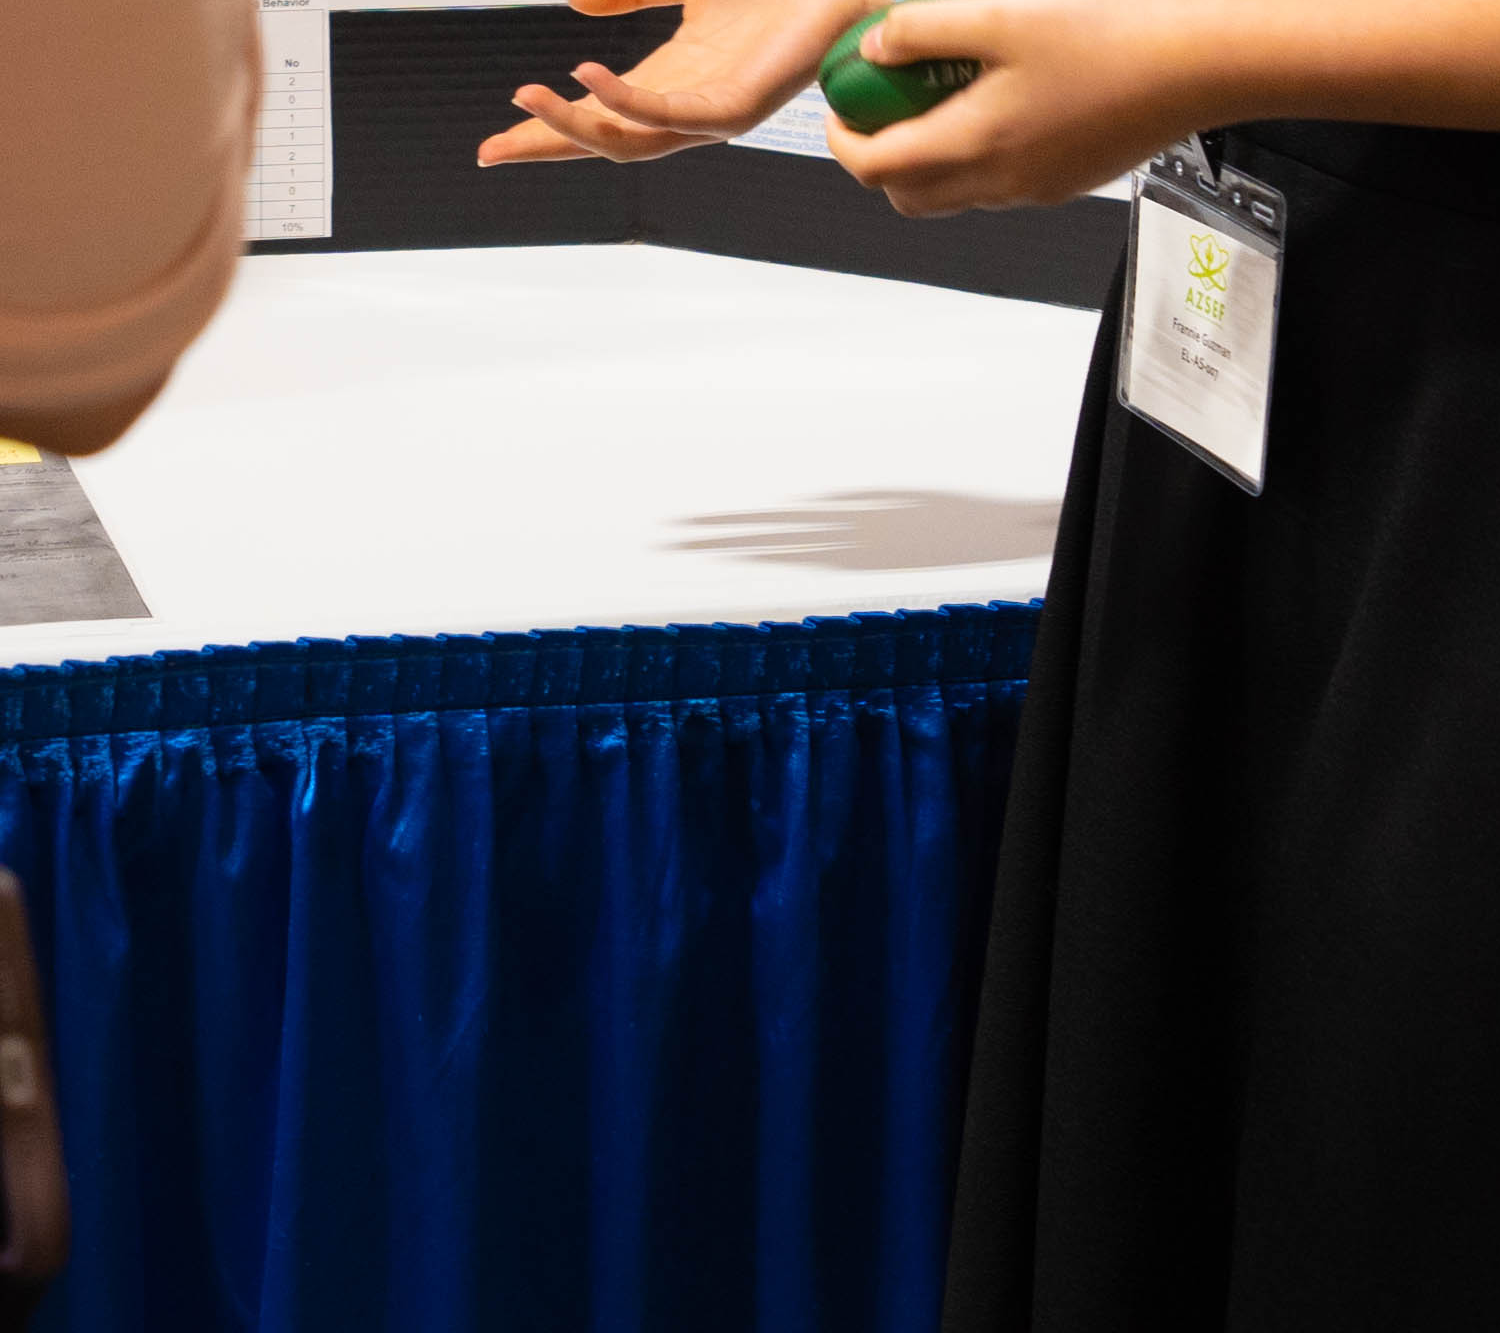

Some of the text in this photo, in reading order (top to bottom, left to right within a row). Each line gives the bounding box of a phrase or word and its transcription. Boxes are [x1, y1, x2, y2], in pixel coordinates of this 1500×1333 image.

[284, 59, 300, 68] No
[282, 223, 304, 232] 10%
[1185, 287, 1226, 322] AZSEF
